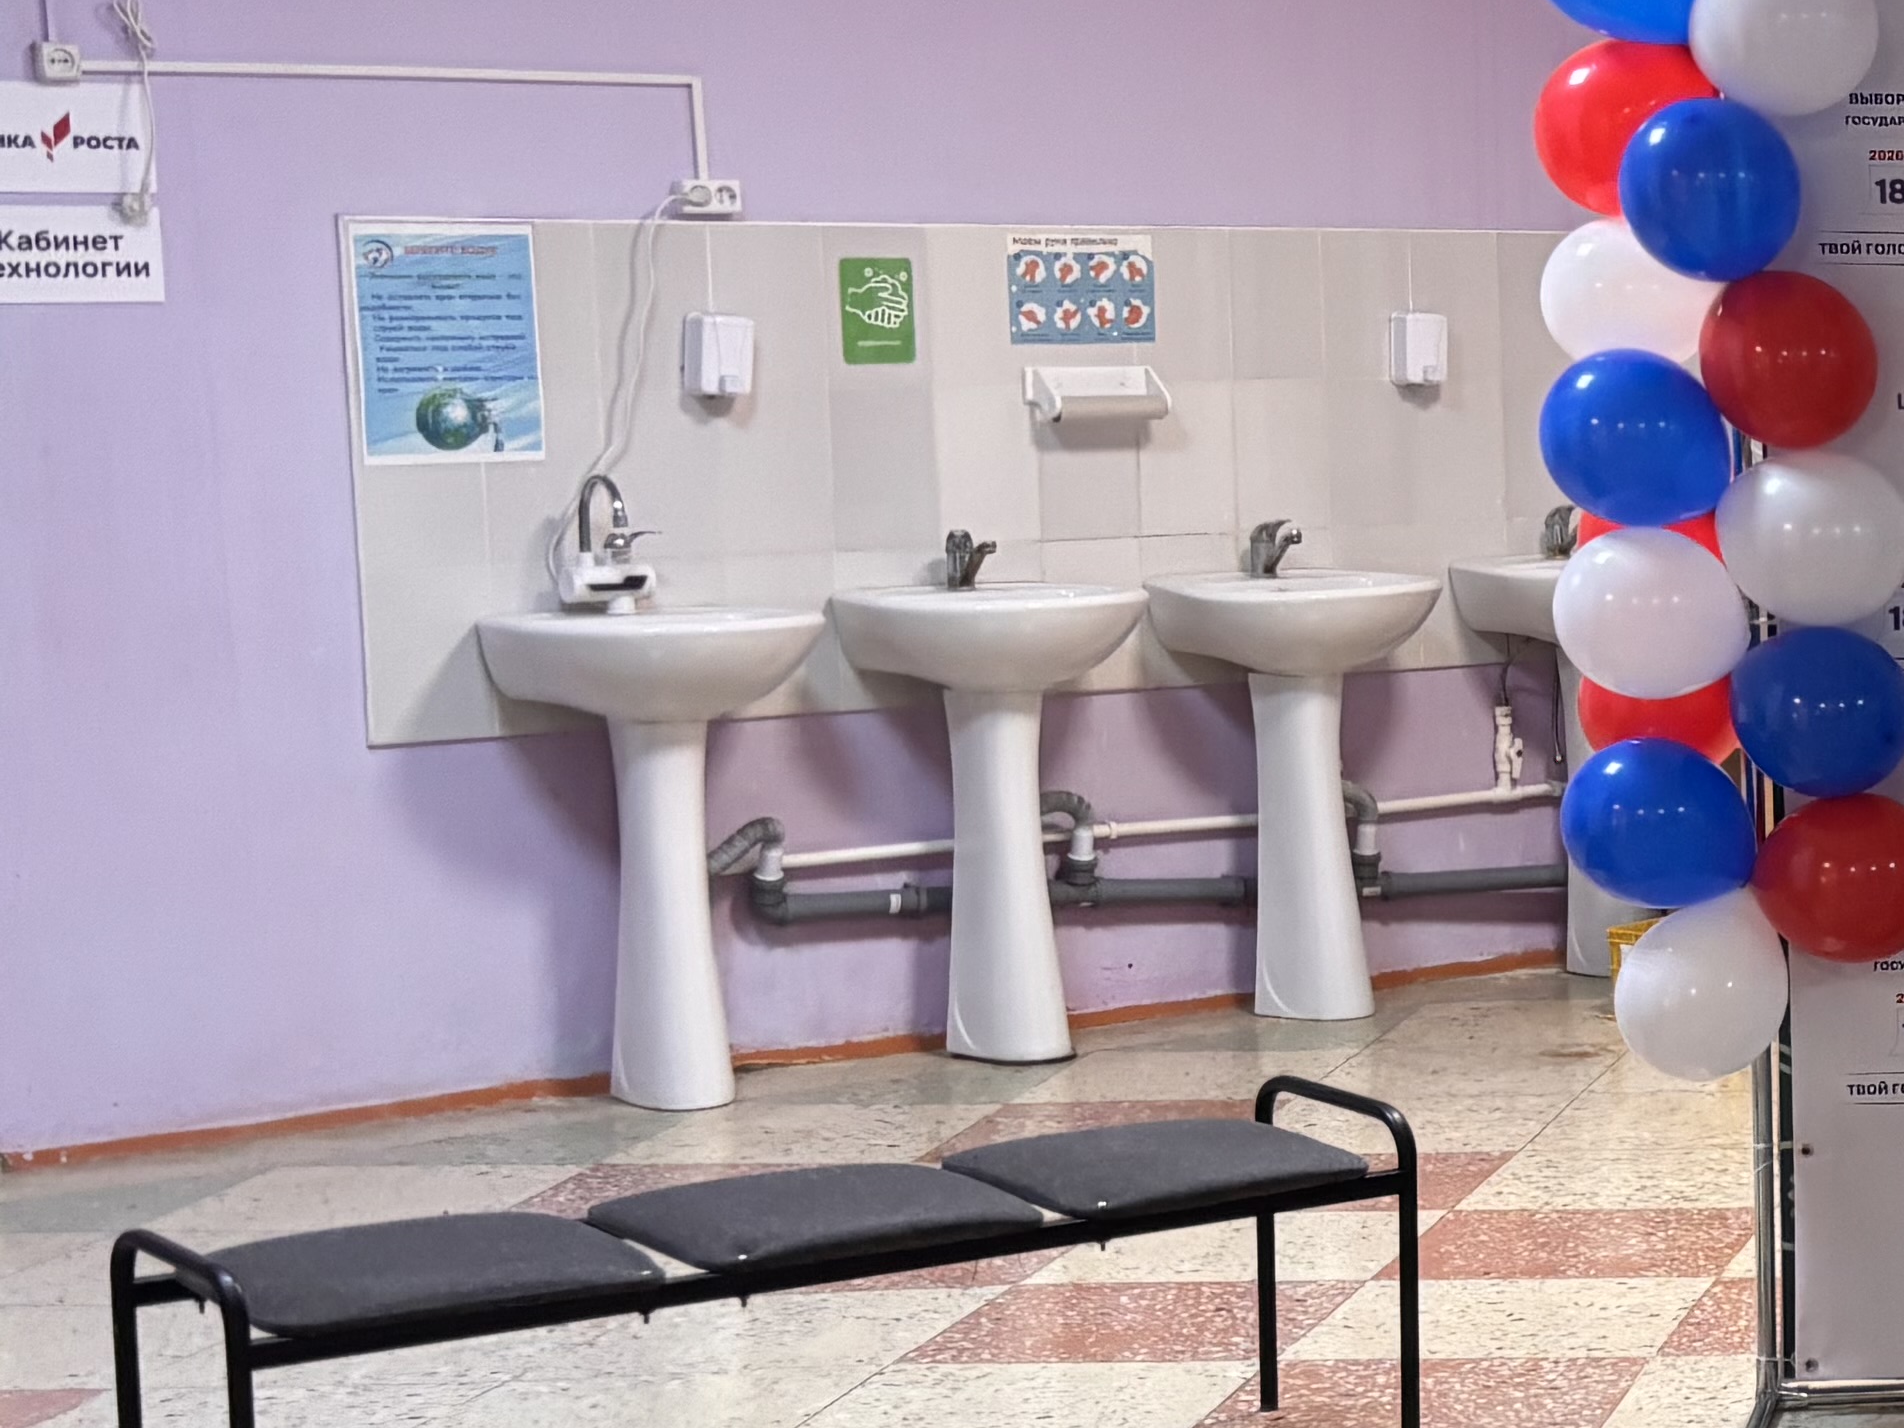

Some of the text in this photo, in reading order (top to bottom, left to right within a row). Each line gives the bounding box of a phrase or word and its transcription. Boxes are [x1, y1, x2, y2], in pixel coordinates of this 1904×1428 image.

[73, 136, 140, 150] РОСТА
[1869, 150, 1904, 161] 2026
[0, 230, 124, 251] Кабинет
[1818, 240, 1862, 256] ТВОЙ
[1847, 1080, 1888, 1096] ТВОЙ
